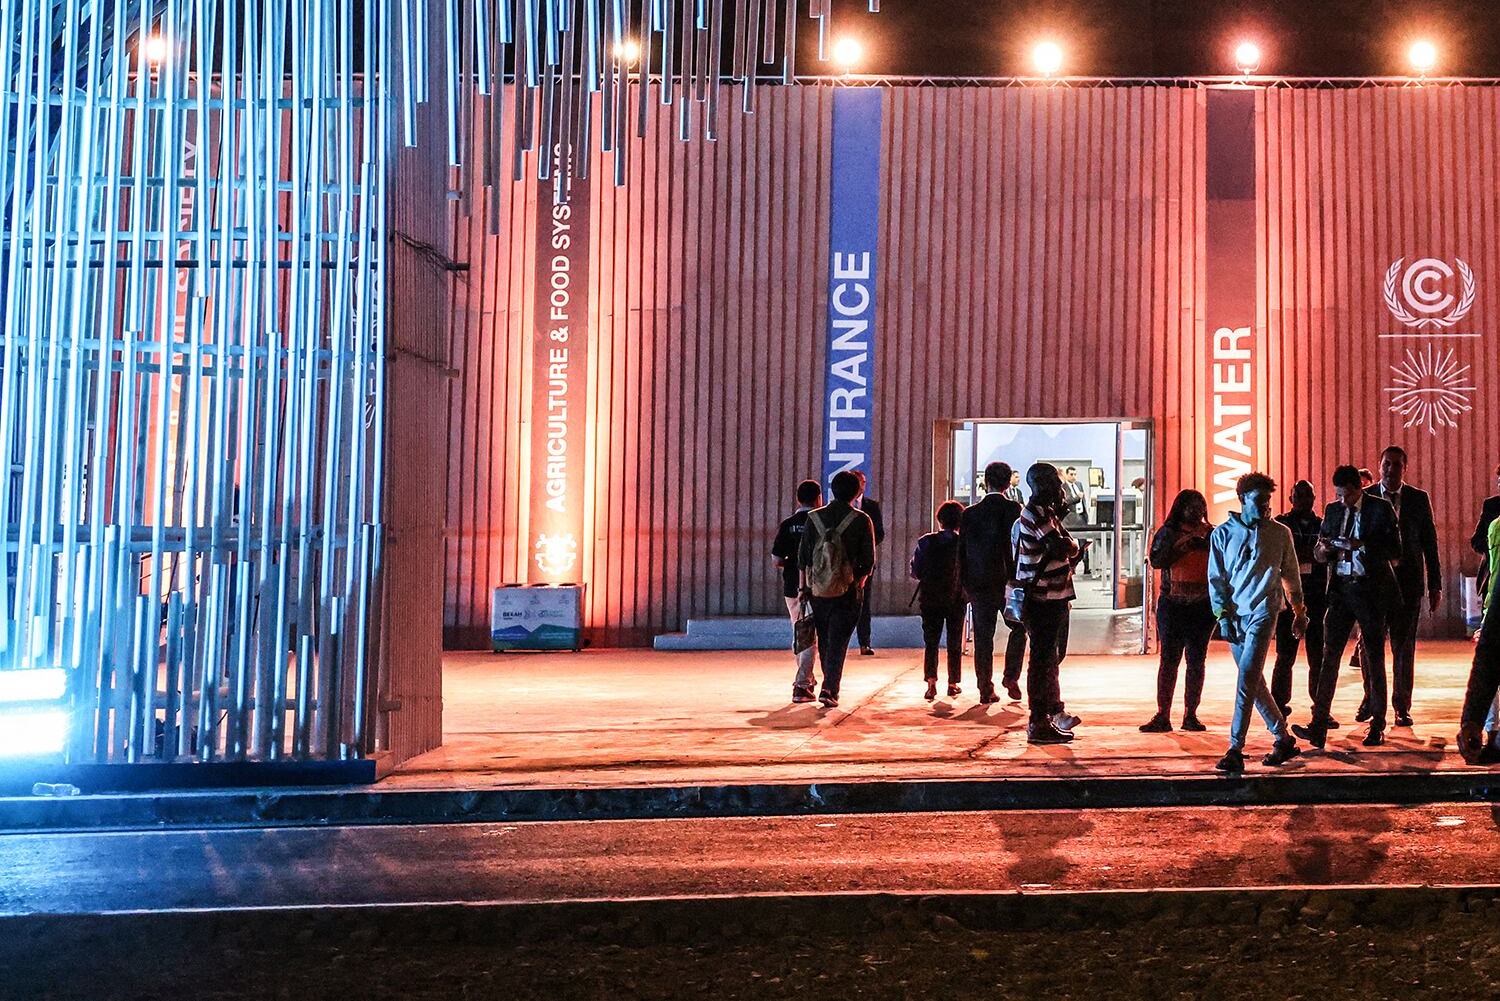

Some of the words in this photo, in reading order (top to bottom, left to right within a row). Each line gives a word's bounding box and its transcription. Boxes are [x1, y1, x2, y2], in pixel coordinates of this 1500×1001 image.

[550, 325, 569, 343] &
[551, 255, 571, 320] FOOD
[546, 348, 569, 513] AGRICULTURE
[828, 250, 870, 503] NTRANCE
[1213, 327, 1252, 504] WATER
